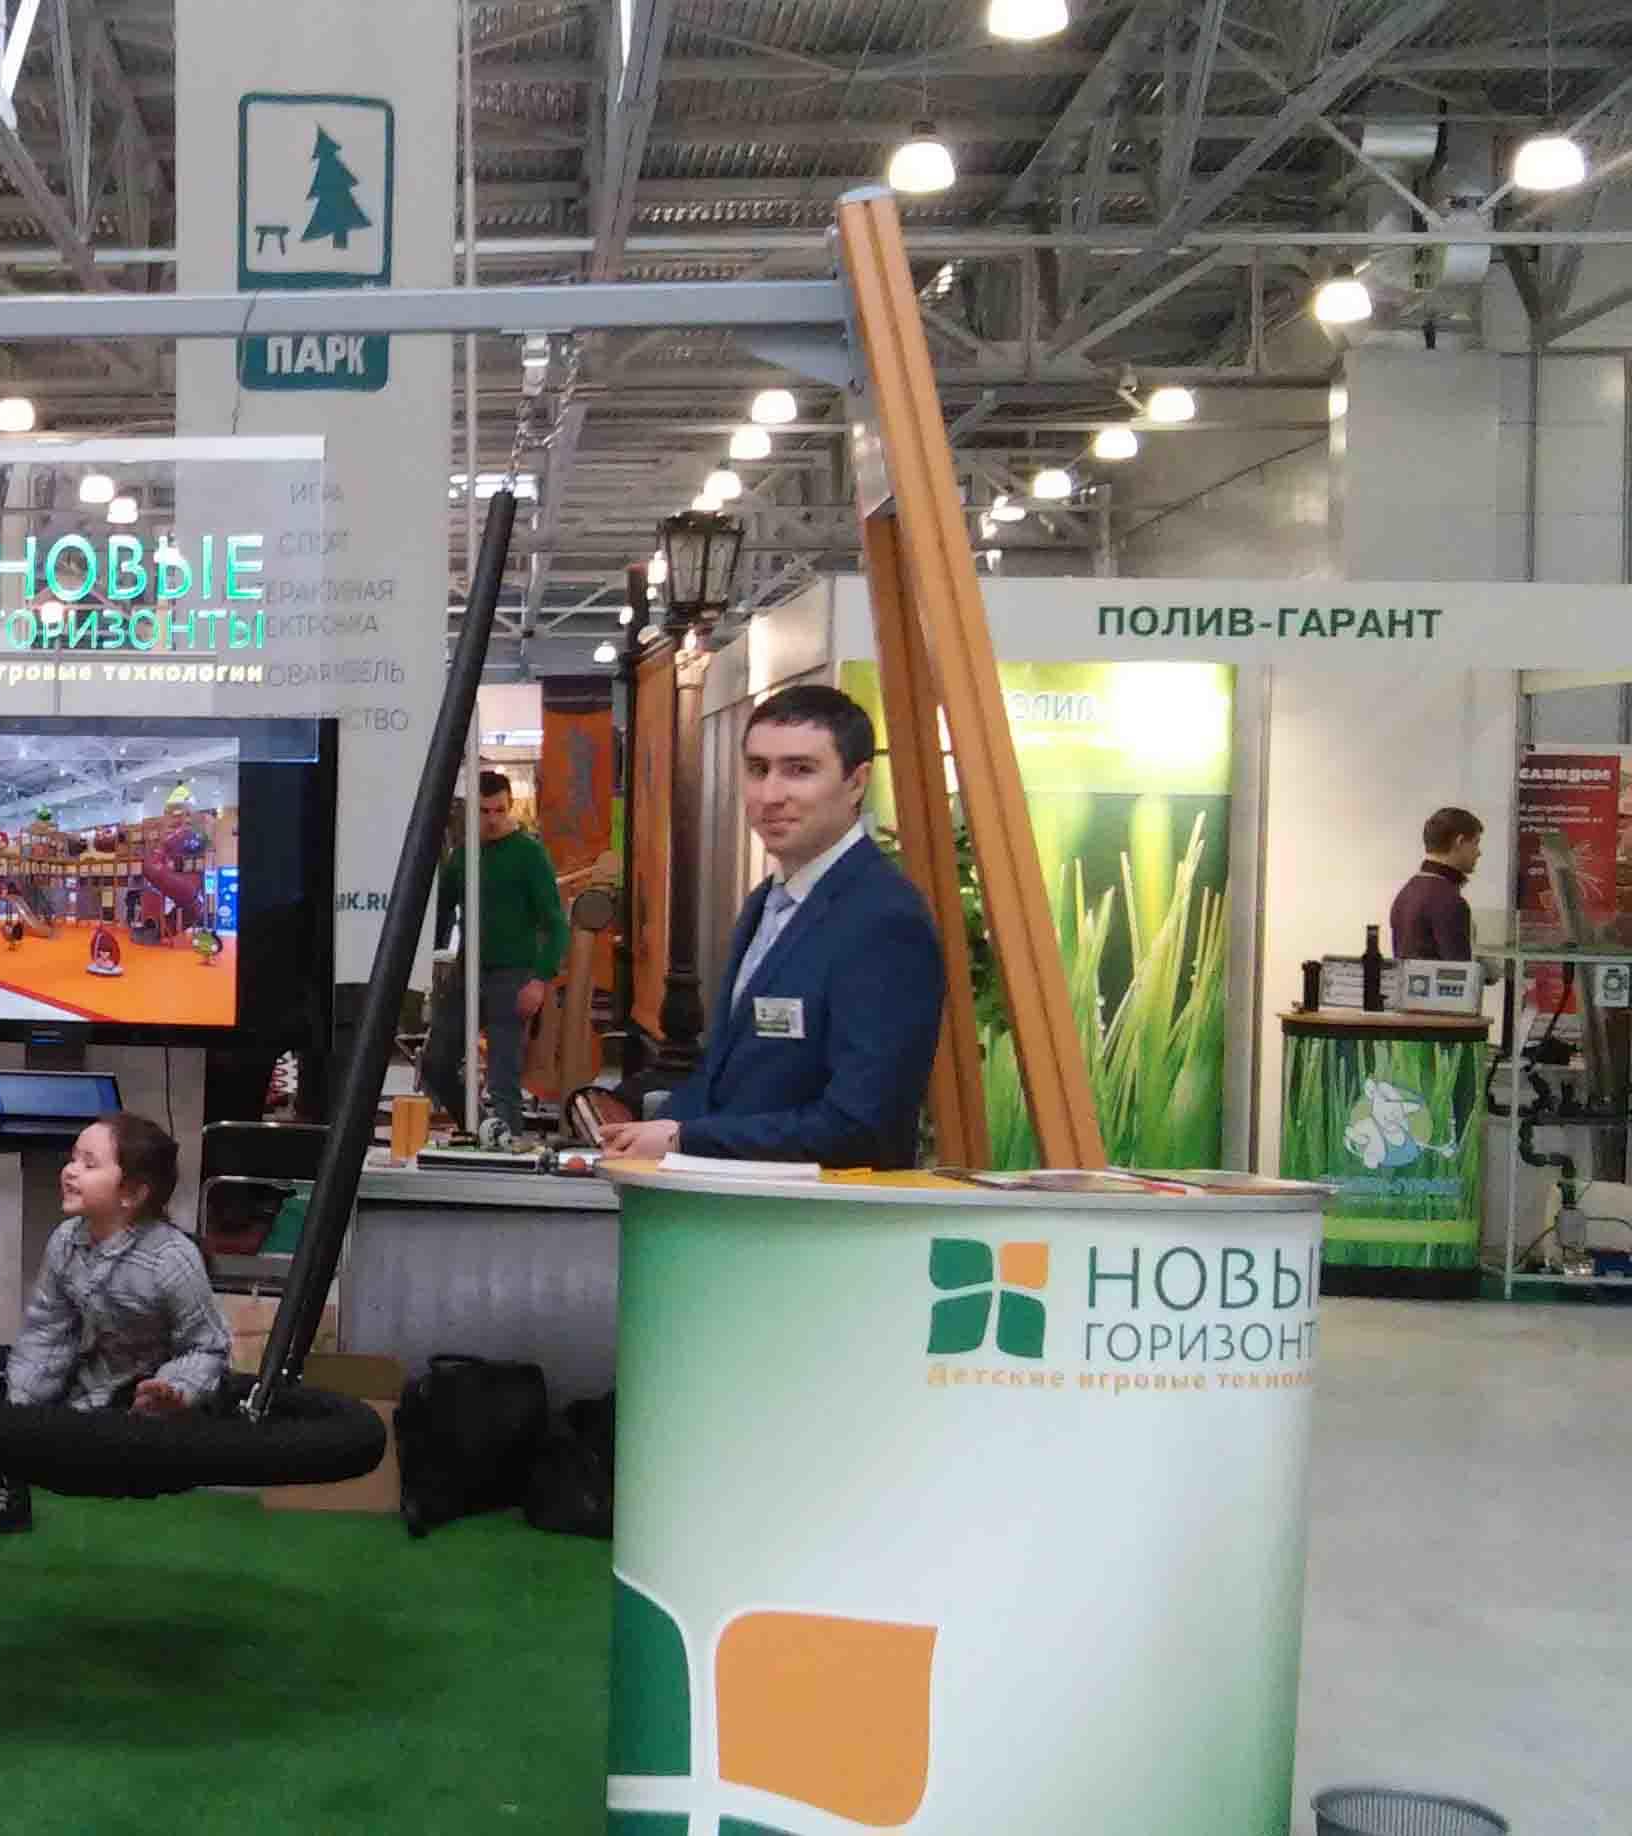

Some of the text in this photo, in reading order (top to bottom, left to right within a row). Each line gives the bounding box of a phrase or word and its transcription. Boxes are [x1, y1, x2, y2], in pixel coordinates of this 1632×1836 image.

[267, 336, 366, 375] ПАРК
[1097, 605, 1443, 639] ПОЛИВ-ГАРАНТ
[102, 664, 264, 685] технологии
[1087, 1245, 1316, 1312] НОВЫ
[927, 1364, 1066, 1390] Детские
[1078, 1369, 1208, 1396] игровые
